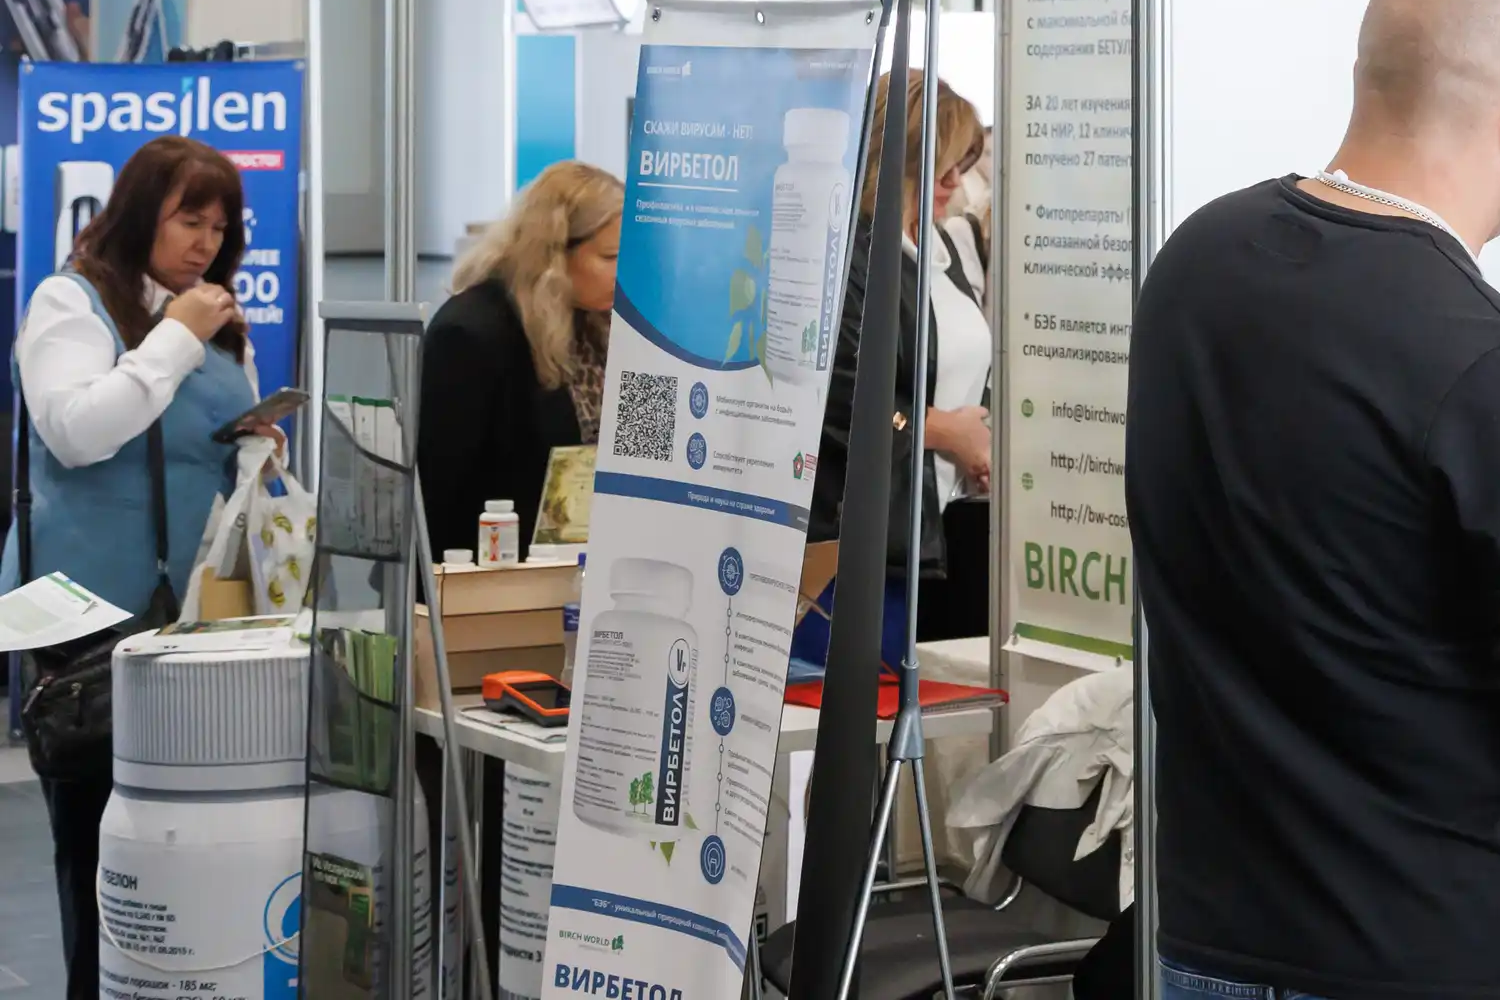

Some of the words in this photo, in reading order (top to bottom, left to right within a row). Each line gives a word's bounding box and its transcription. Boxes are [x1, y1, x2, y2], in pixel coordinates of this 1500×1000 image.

[1097, 38, 1130, 56] БЕТУЛ
[36, 76, 287, 143] spasilen
[640, 150, 740, 182] ВИРБЕТОЛ
[1097, 154, 1131, 168] патент
[1102, 234, 1131, 253] безоп
[1101, 263, 1131, 284] эффе
[1022, 342, 1129, 367] специализированн
[1051, 400, 1126, 427] info@birchwo
[1050, 452, 1125, 477] http://birchw
[1050, 500, 1128, 529] http://bw-cos
[1024, 540, 1128, 606] BIRCH
[662, 691, 686, 824] ВИРБЕТОЛ
[559, 929, 582, 941] BIRCH
[583, 934, 610, 947] WORLD
